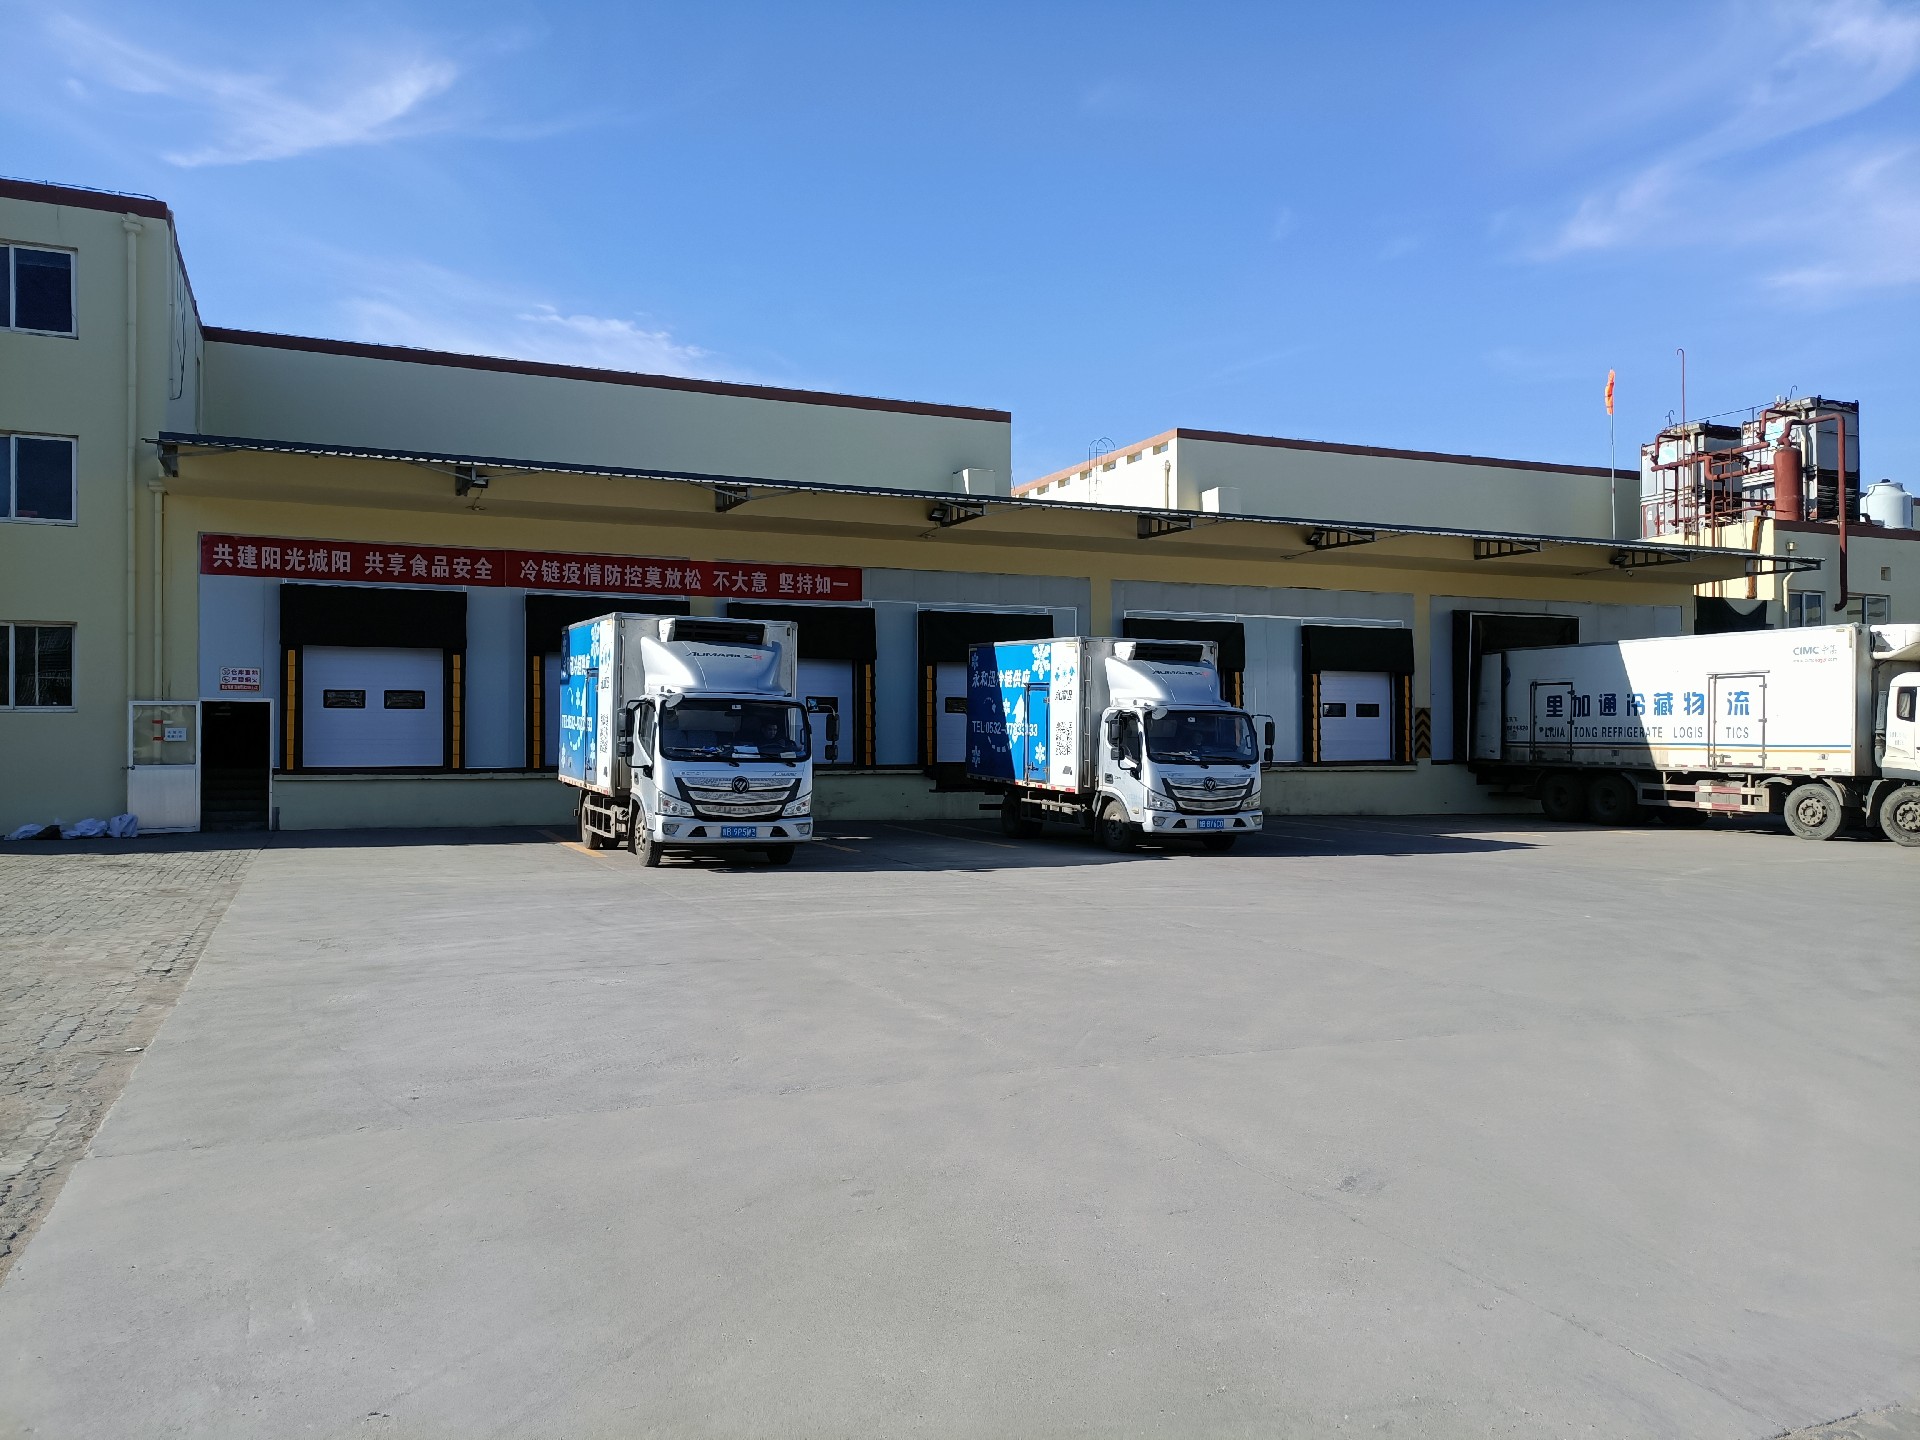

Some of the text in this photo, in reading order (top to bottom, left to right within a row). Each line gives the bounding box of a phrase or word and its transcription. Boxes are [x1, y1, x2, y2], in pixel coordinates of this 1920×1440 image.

[212, 543, 493, 580] 共建阳光城阳 共享食品安全
[519, 559, 849, 594] 冷链疫情防控莫放松 不大意 坚持如一
[1793, 646, 1819, 655] CIMC
[1545, 689, 1751, 718] 里加通冷藏物流
[1574, 726, 1598, 738] TONG
[1601, 726, 1663, 739] REFRIGERATE
